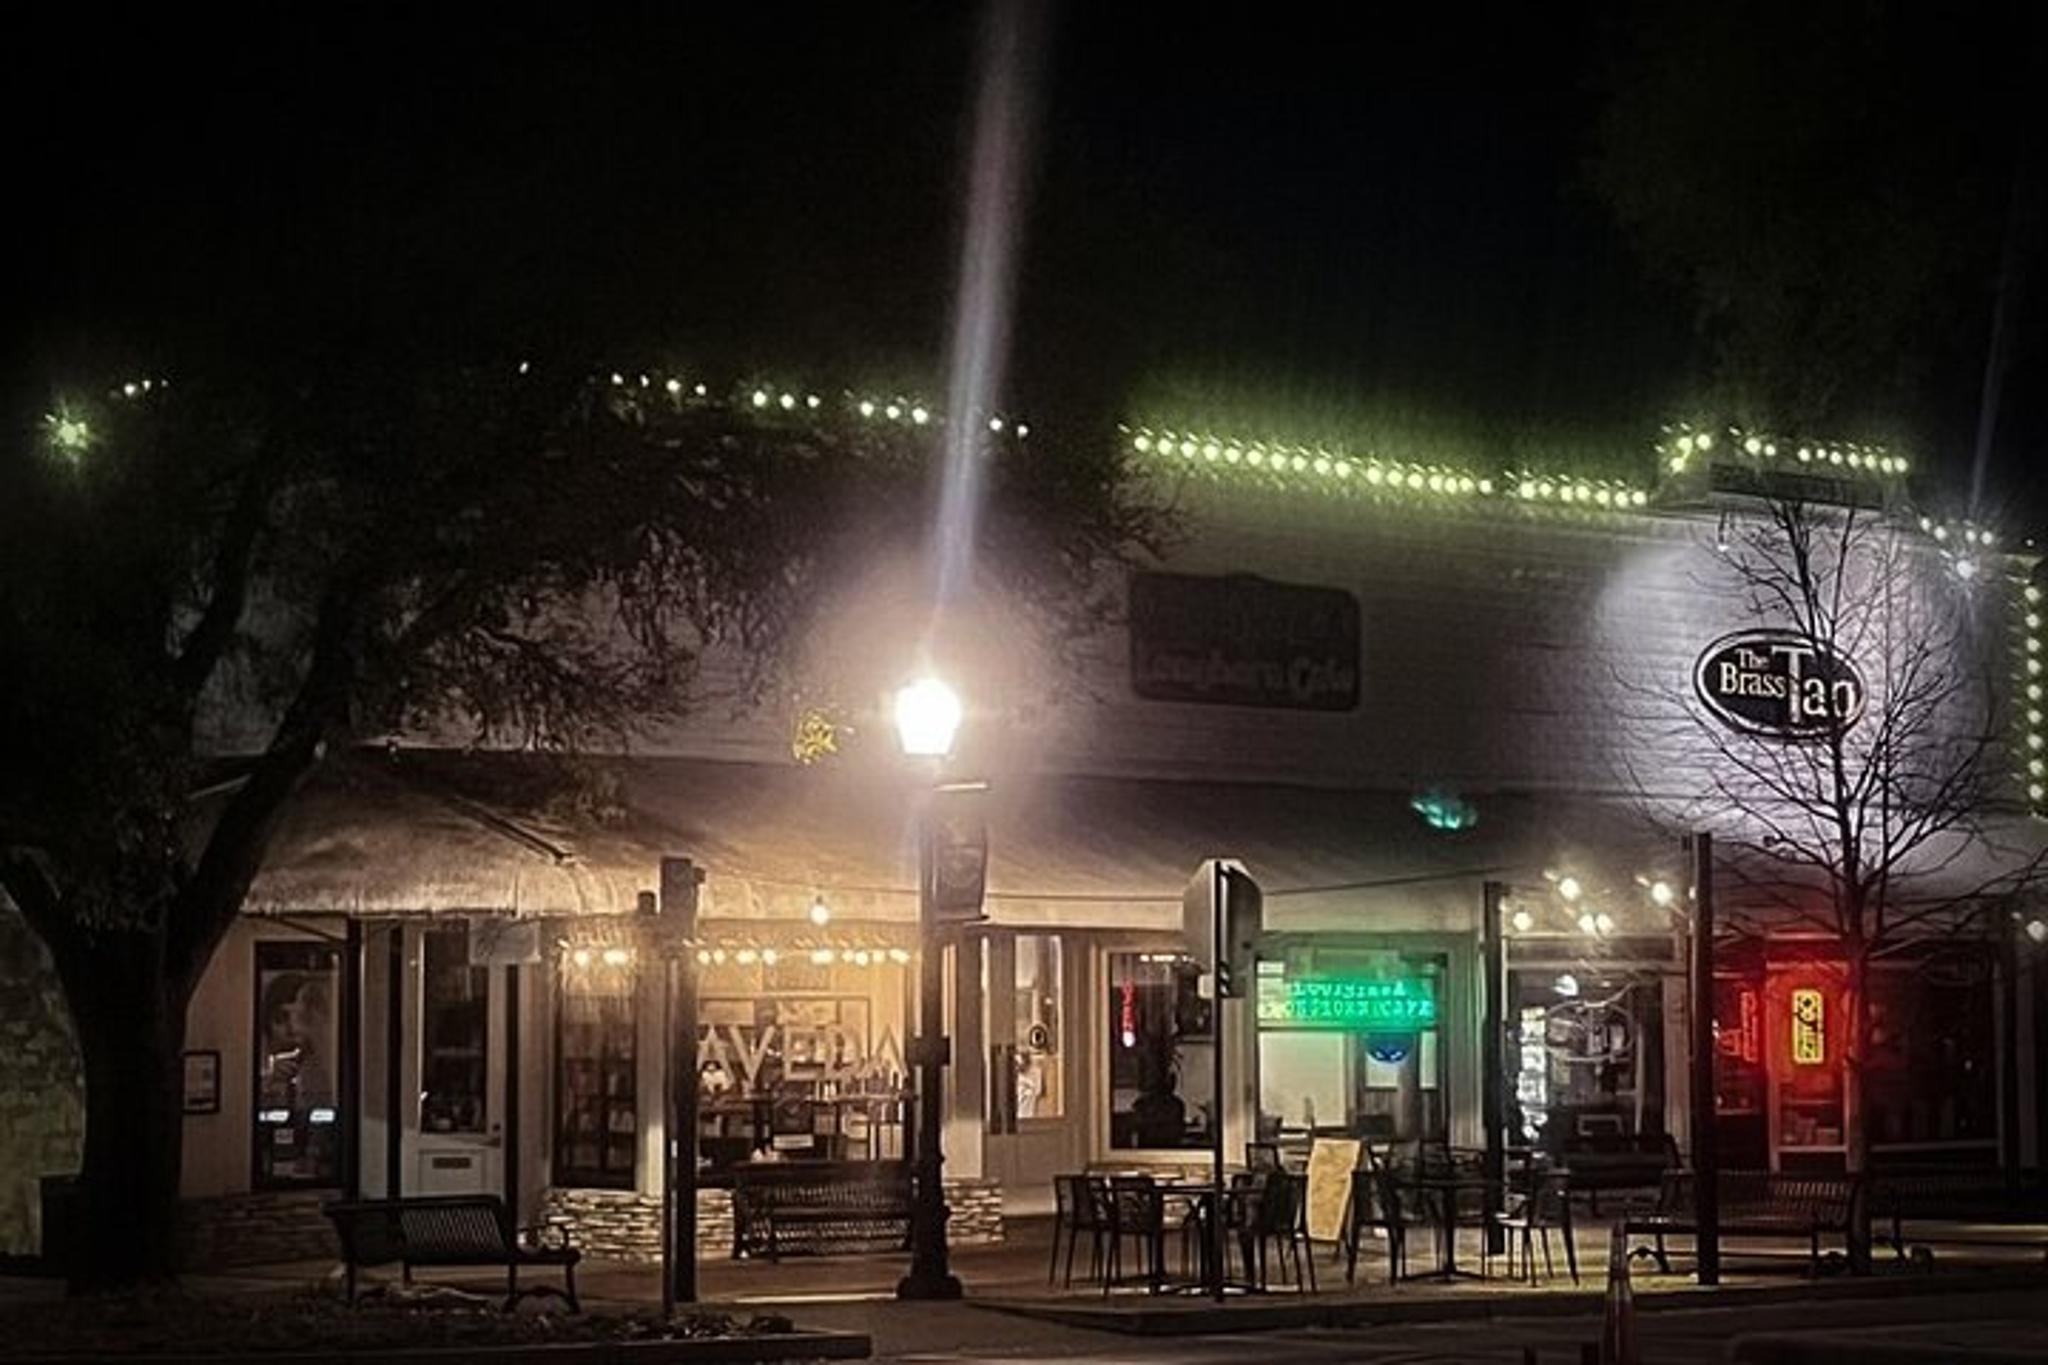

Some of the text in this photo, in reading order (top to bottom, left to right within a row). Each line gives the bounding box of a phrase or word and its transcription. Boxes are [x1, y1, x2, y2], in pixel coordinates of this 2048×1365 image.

[1736, 648, 1770, 669] The
[1719, 661, 1786, 698] Brass
[697, 1024, 908, 1086] AVEDA
